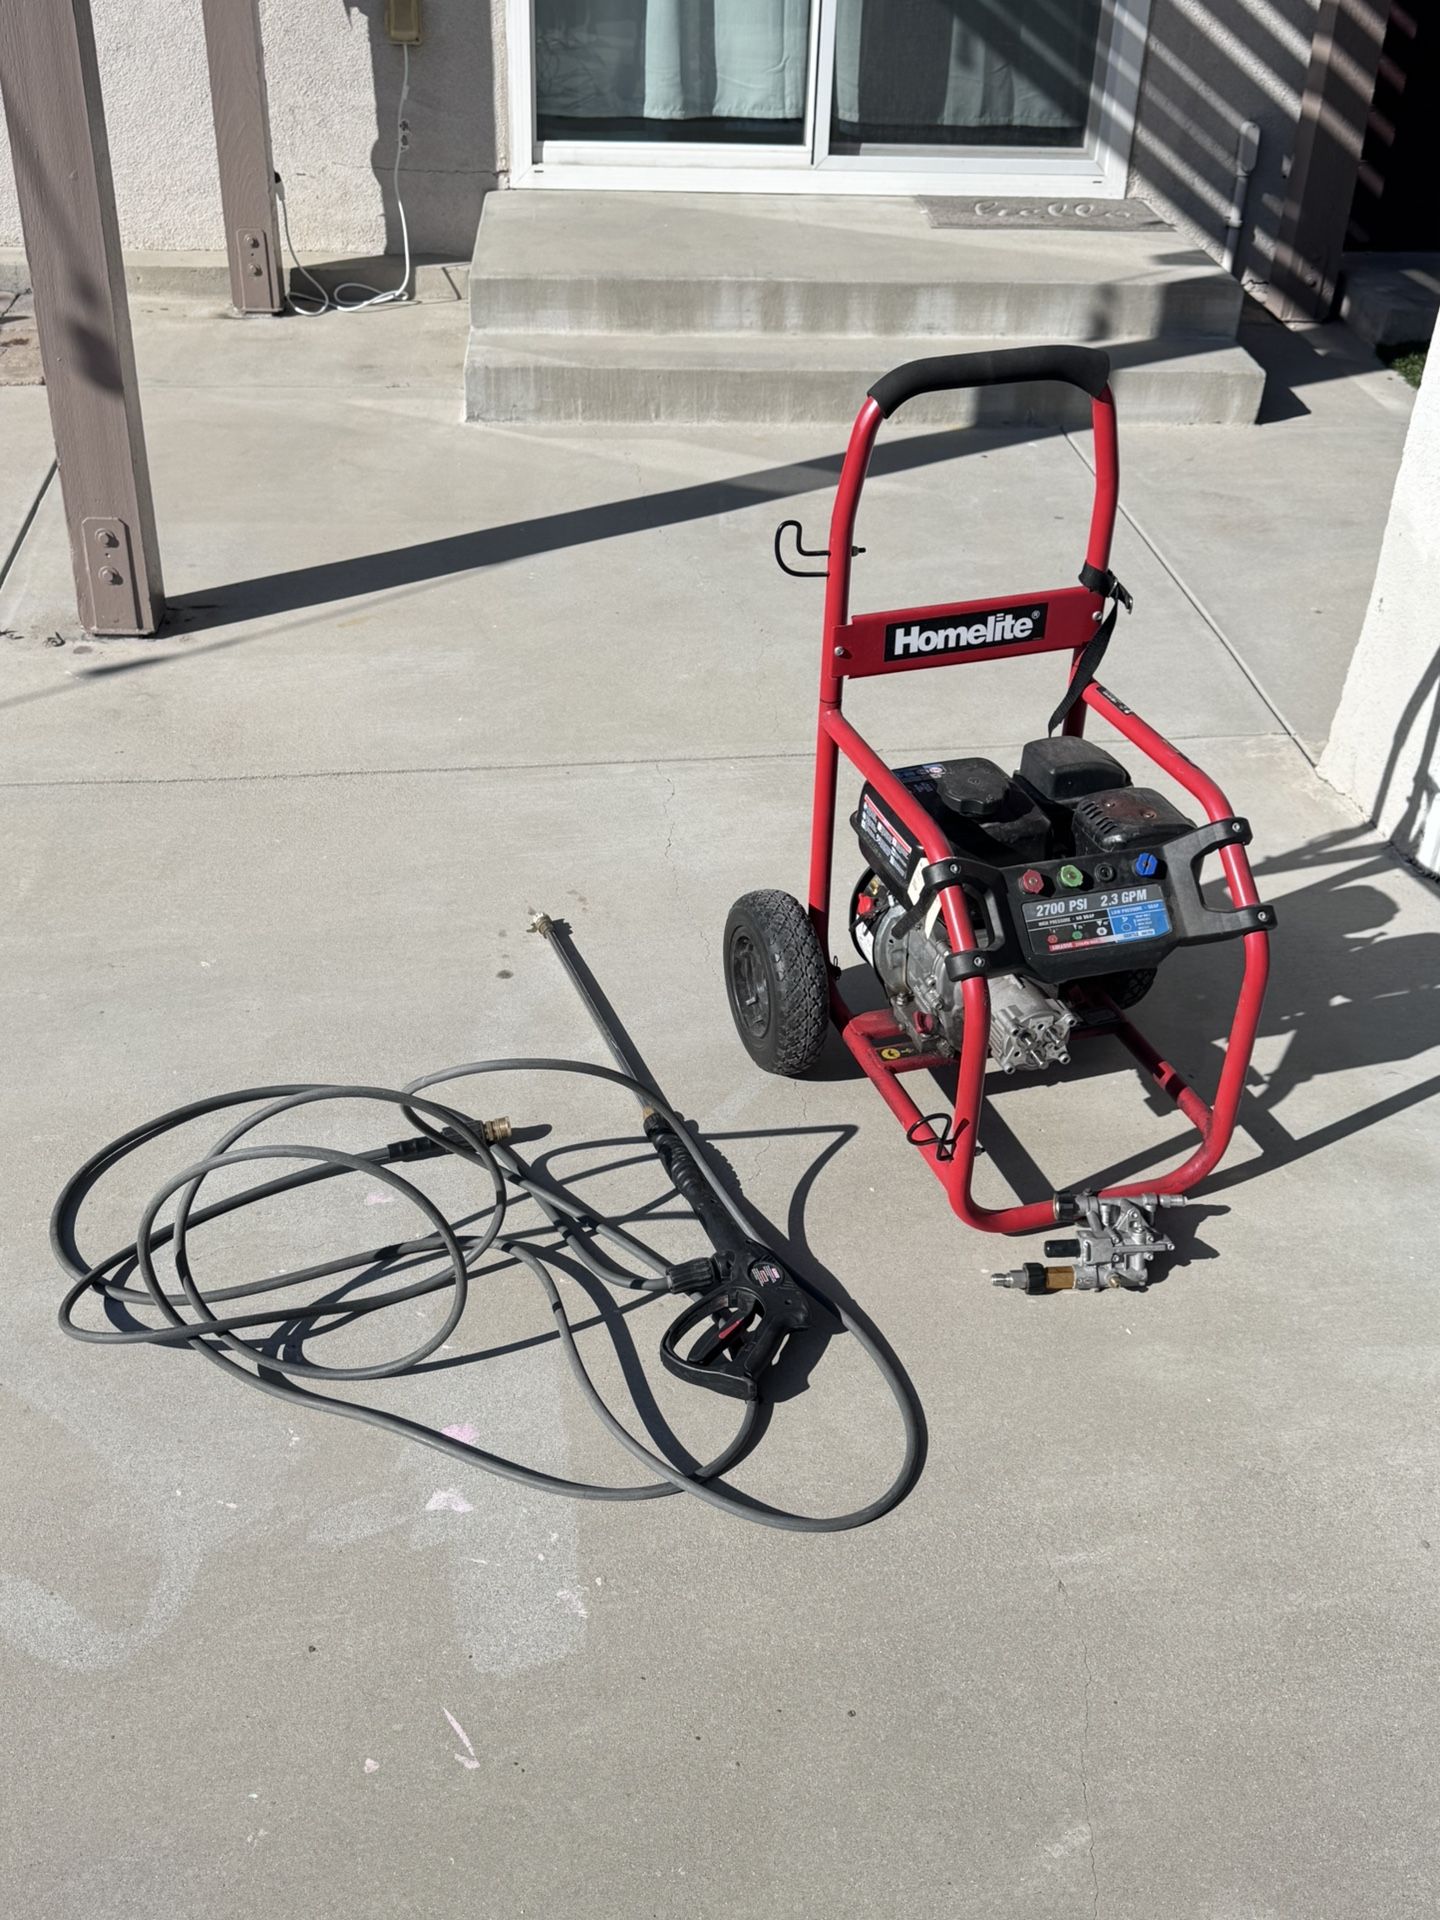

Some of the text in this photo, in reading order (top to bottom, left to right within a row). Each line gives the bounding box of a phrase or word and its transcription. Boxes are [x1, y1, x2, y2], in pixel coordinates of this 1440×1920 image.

[1036, 889, 1147, 917] 2700 PSI 2.3 GPM
